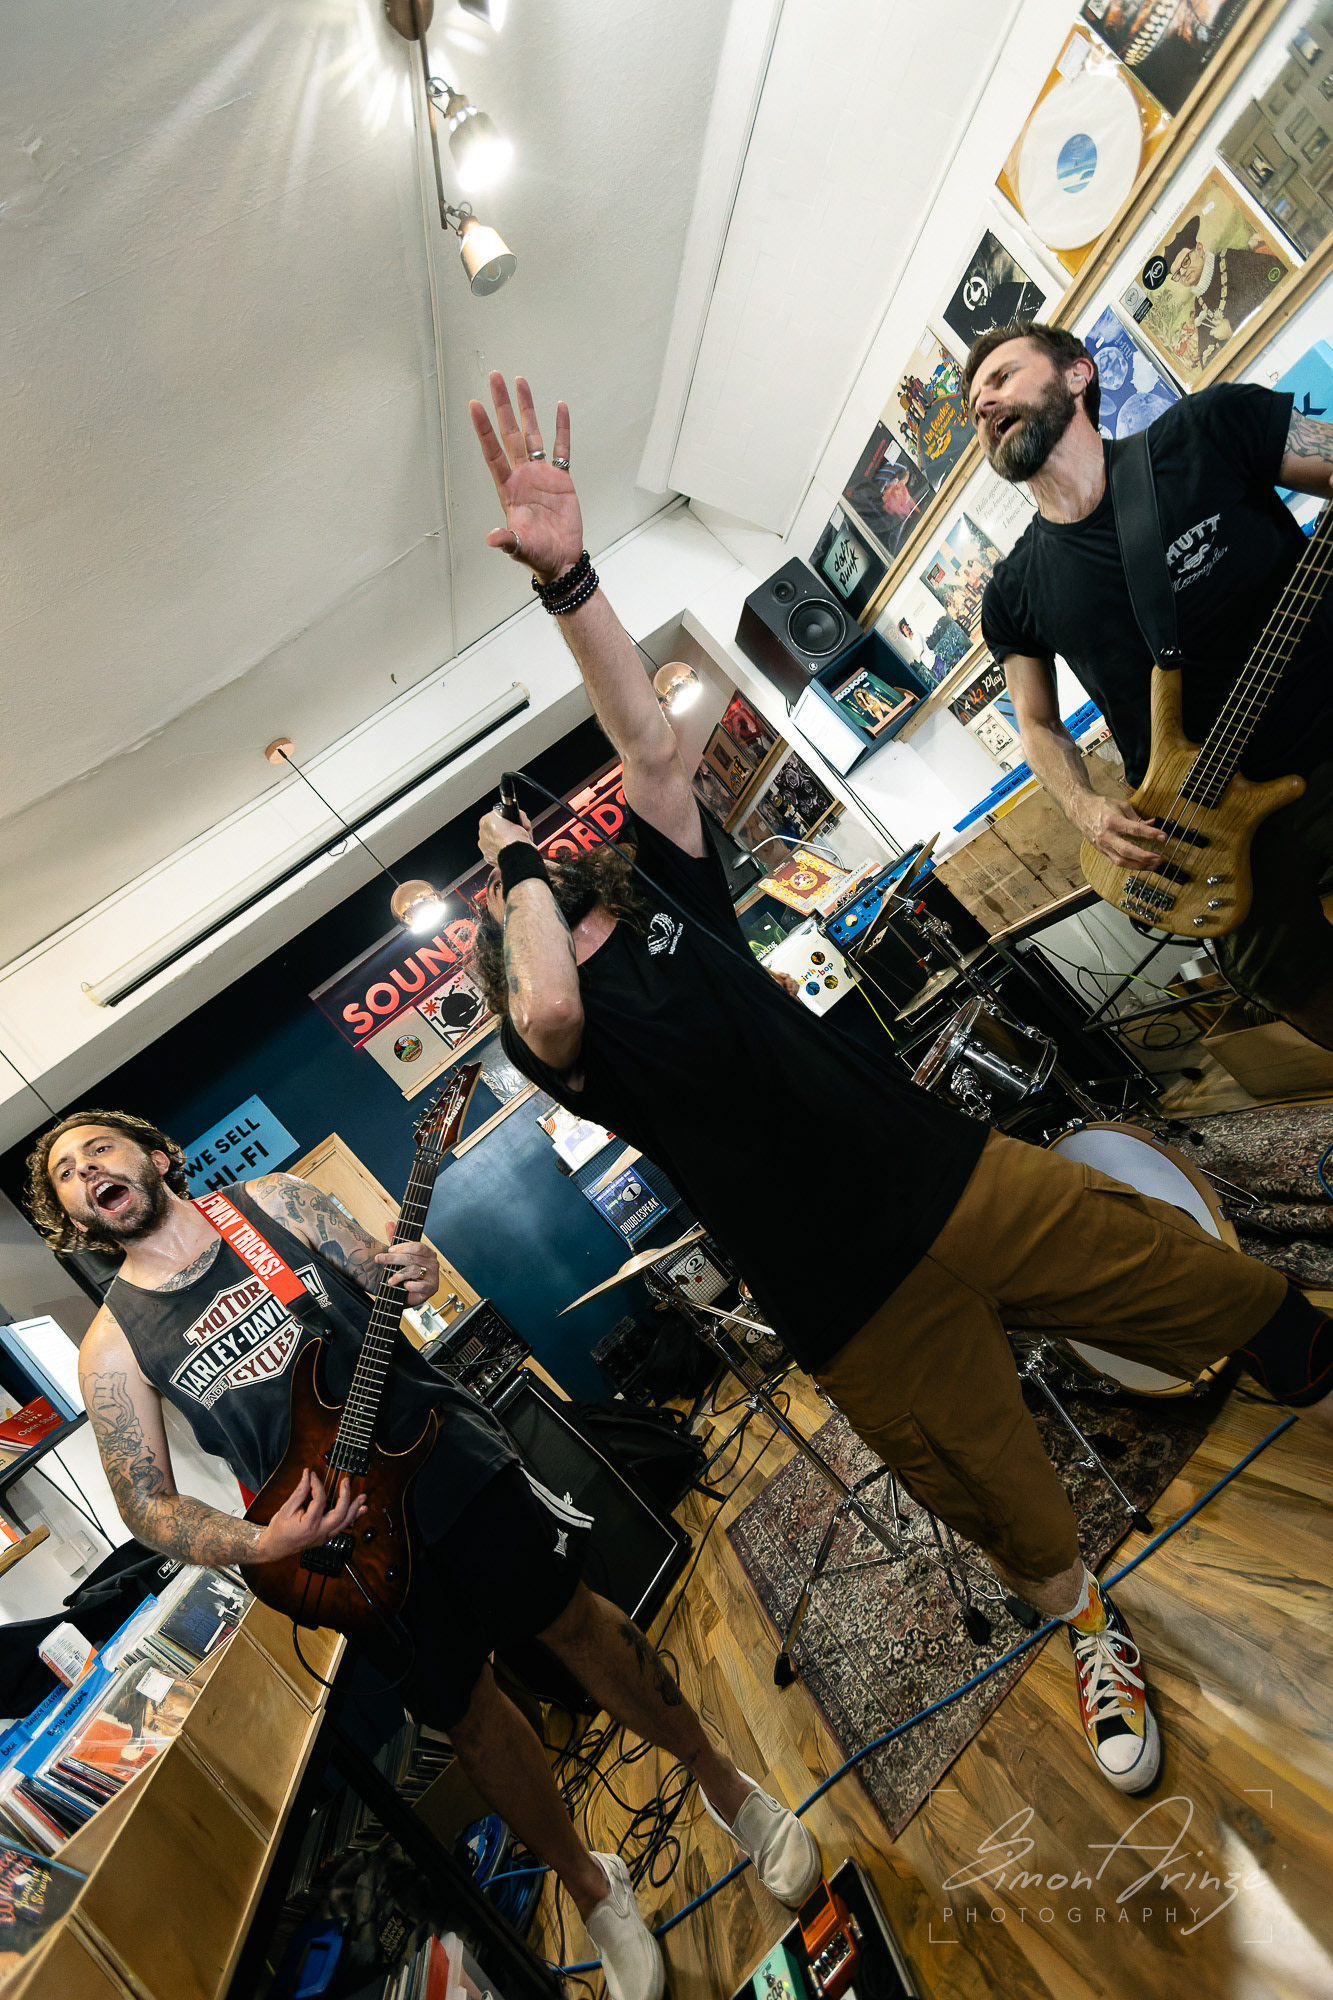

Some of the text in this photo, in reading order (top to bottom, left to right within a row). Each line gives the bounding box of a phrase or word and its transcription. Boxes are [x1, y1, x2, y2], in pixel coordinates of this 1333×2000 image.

[834, 538, 850, 573] daft
[1166, 513, 1220, 566] MUTT
[839, 548, 859, 592] punk
[964, 672, 1005, 710] 4 U2 Play
[756, 941, 778, 960] eaking
[818, 962, 834, 976] bop
[343, 919, 478, 1034] SOUND
[797, 968, 816, 985] birth
[184, 1117, 260, 1178] WE SELL
[204, 1140, 269, 1192] HI-FI
[620, 1197, 660, 1235] DOUBLESPEAK
[195, 1192, 286, 1281] LFWAY TRICKS!
[689, 1258, 703, 1271] 2
[194, 1280, 264, 1341] MOTOR
[232, 1327, 295, 1383] CYCLES
[13, 1408, 35, 1422] SITE
[17, 1423, 41, 1436] Open
[3, 1741, 18, 1756] BACH
